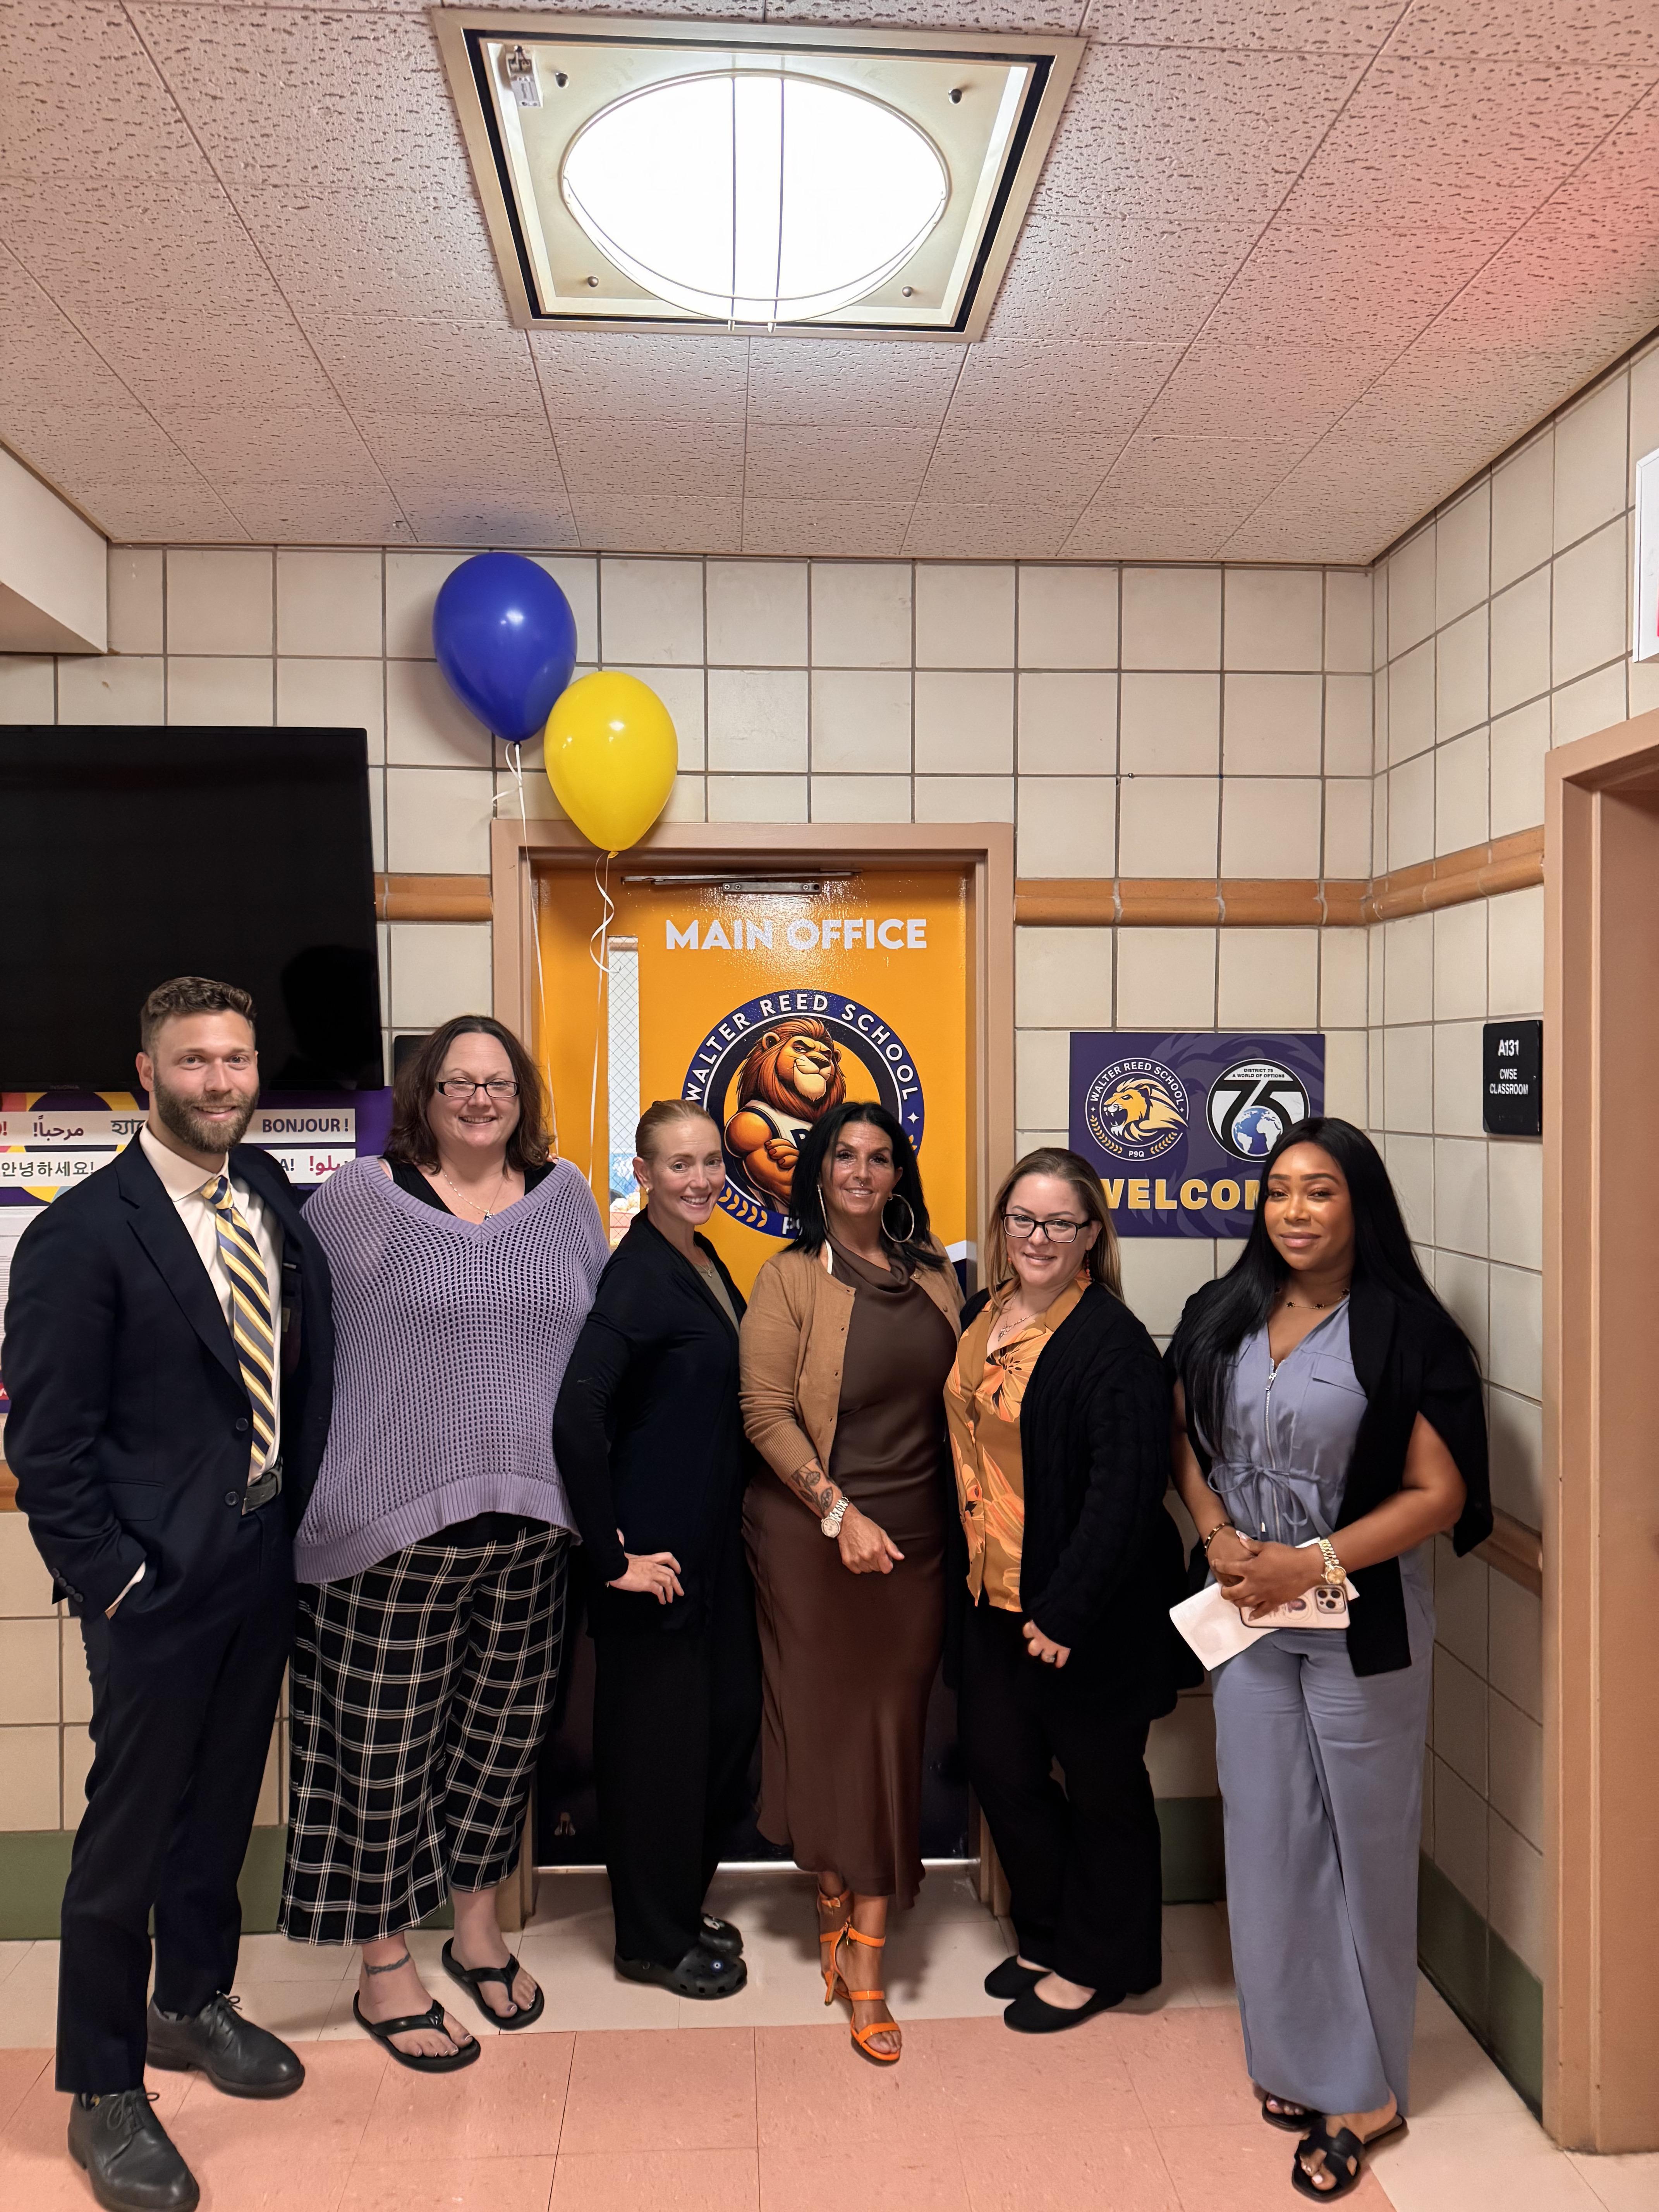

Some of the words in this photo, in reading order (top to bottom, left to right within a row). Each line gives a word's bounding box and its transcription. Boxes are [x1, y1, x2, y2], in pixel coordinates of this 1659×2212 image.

[666, 919, 773, 950] MAIN
[787, 918, 927, 951] OFFICE
[685, 1013, 751, 1101] WALTER
[759, 993, 828, 1017] REED
[841, 1004, 918, 1100] SCHOOL
[1498, 1039, 1519, 1056] A131
[1499, 1068, 1517, 1080] CWSE
[1090, 1066, 1122, 1102] WALTER
[1123, 1061, 1152, 1071] REED
[1154, 1066, 1184, 1105] SCHOOL
[1489, 1084, 1528, 1094] CLASSROOM
[1, 1161, 94, 1177] 안녕하세요!
